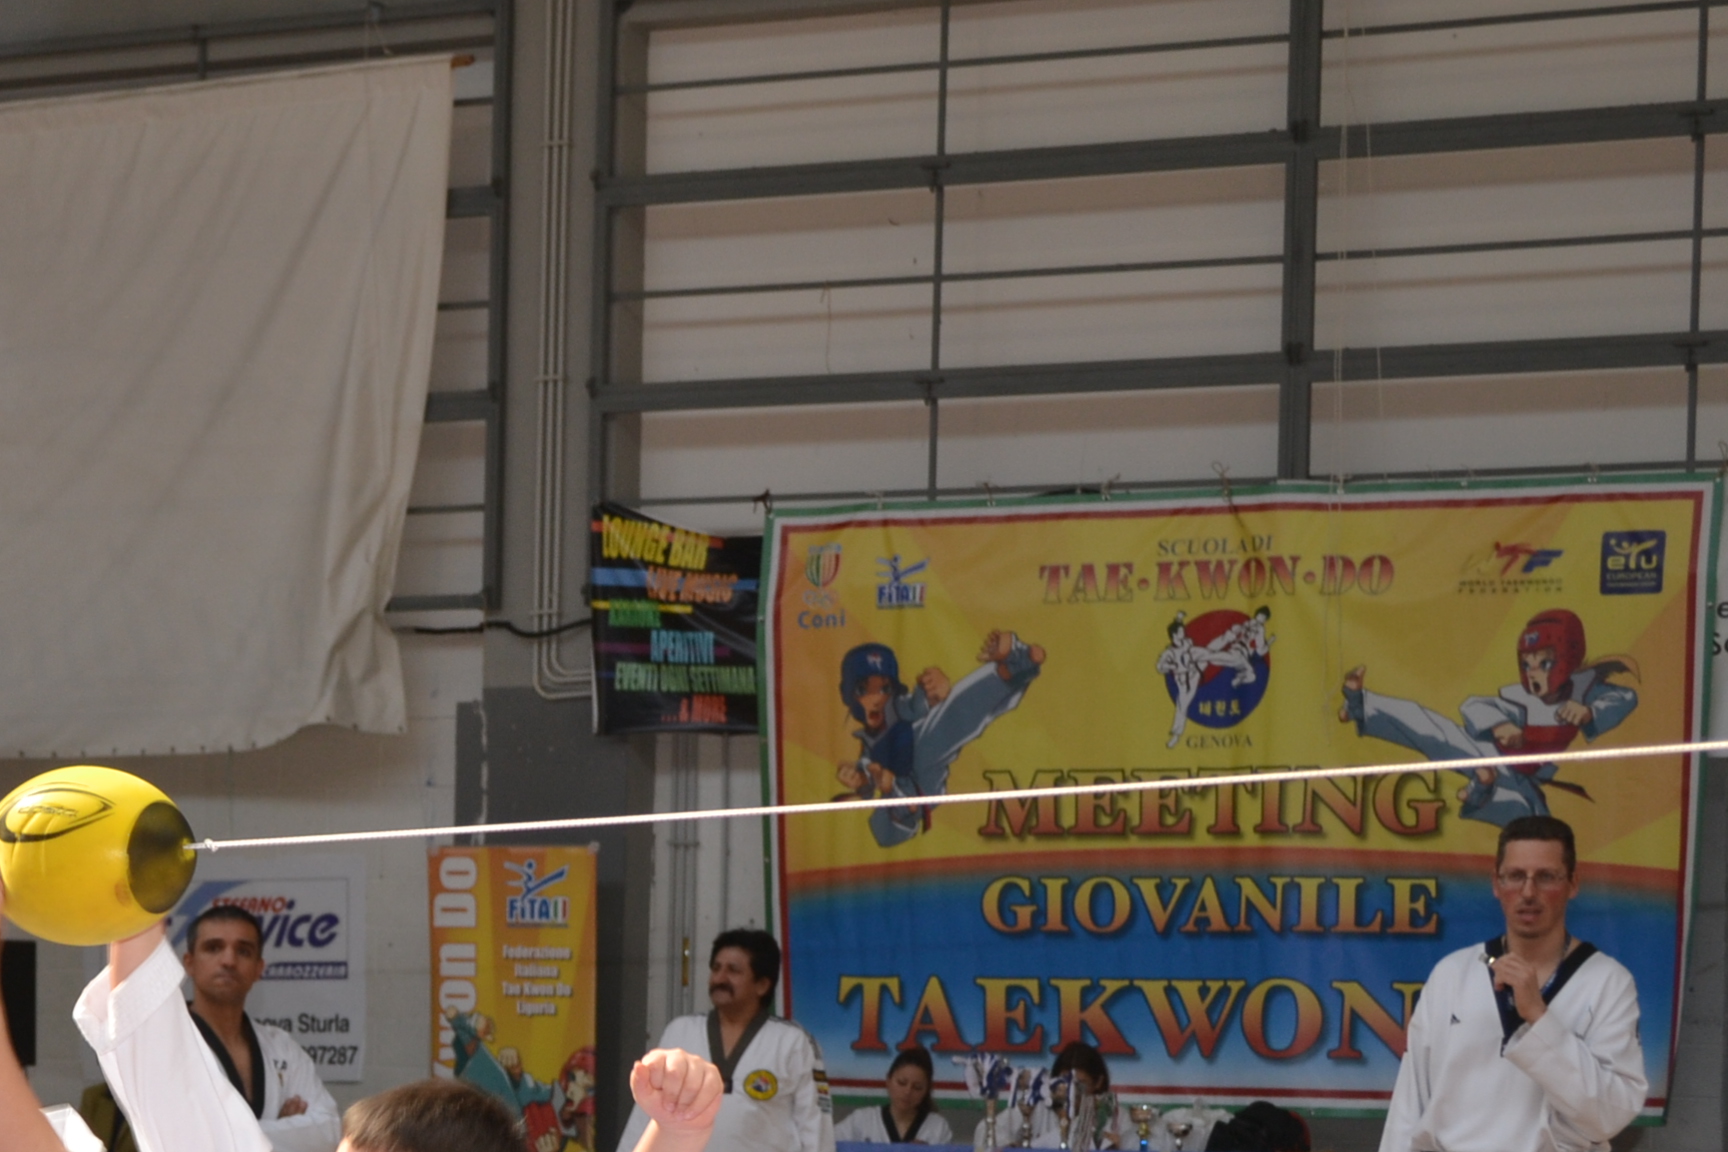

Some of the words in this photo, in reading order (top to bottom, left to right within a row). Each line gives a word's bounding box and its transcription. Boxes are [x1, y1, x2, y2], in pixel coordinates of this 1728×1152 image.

[1158, 538, 1247, 556] SCUOLA
[798, 610, 846, 629] Coni
[1186, 734, 1252, 749] GENOVA
[976, 767, 1447, 840] MEETING
[981, 876, 1440, 936] GIOVANILE
[297, 1012, 350, 1034] Sturla
